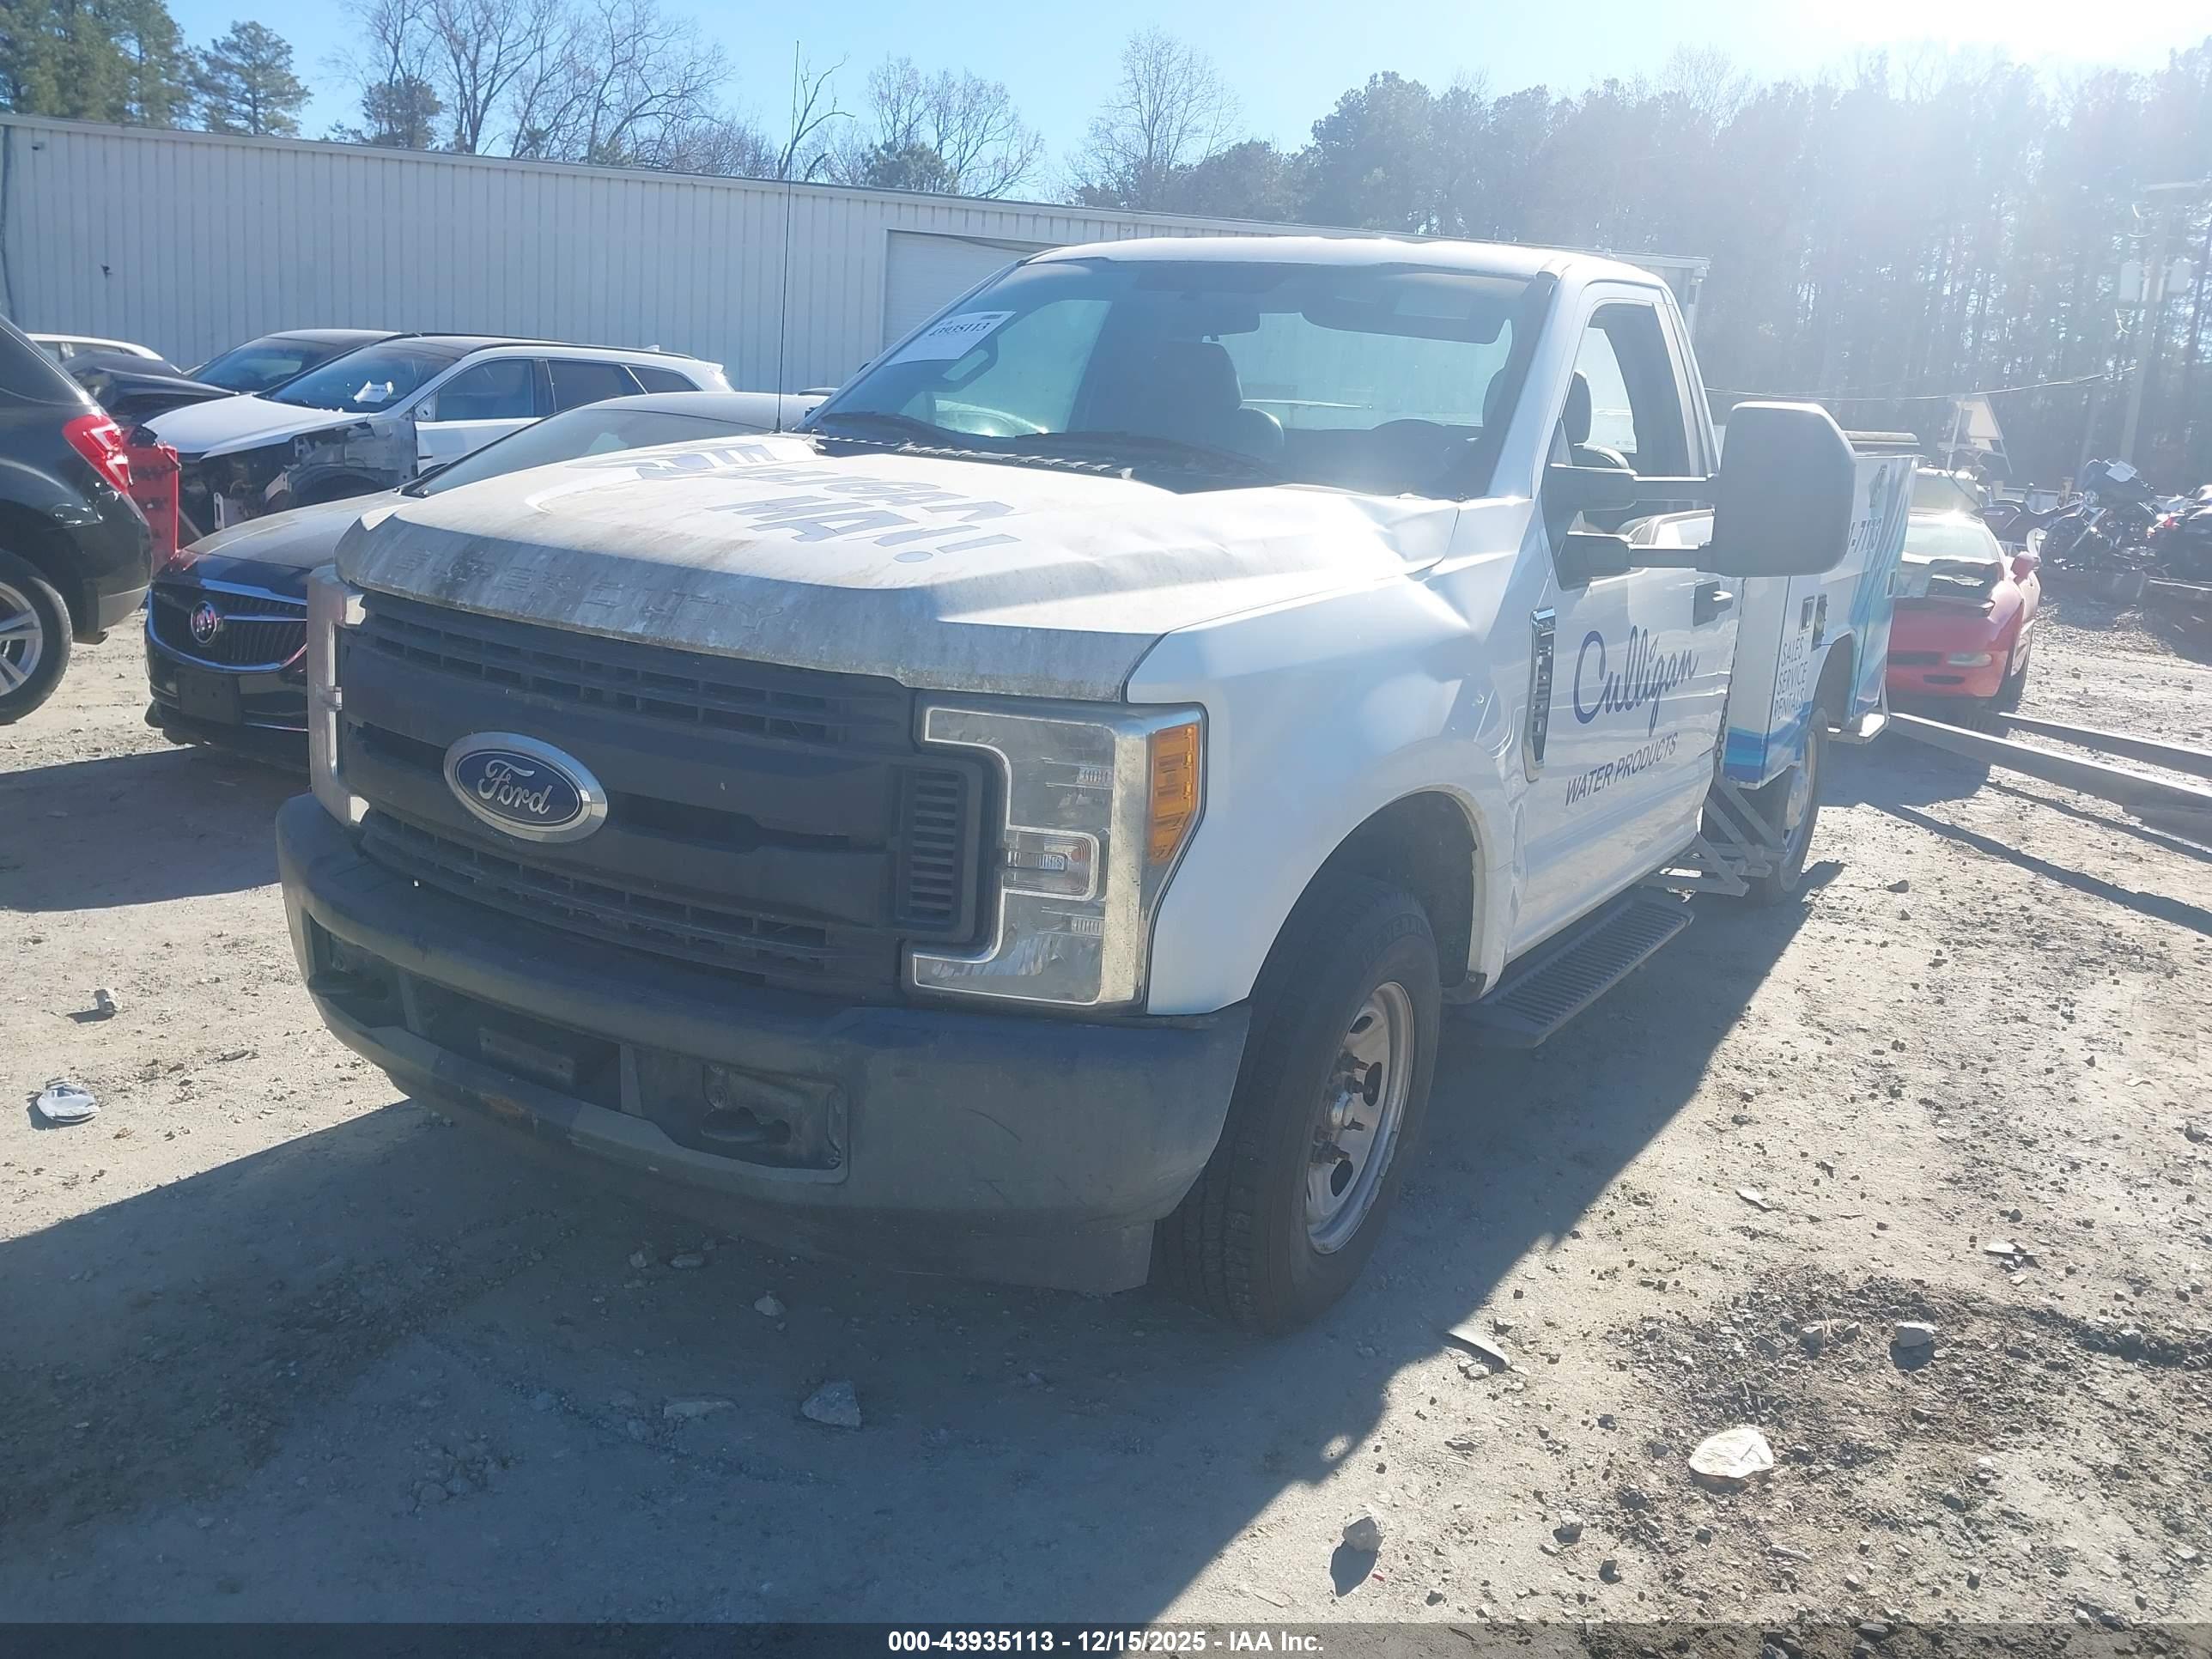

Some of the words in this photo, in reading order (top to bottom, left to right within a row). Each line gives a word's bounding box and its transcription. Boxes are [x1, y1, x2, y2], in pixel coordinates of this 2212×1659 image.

[1781, 635, 1804, 666] SALES
[1573, 625, 1699, 738] Culligan
[1778, 660, 1808, 696] SERVICE
[1773, 687, 1804, 722] RENTALS
[477, 759, 553, 815] Ford
[1565, 762, 1614, 806] WATER
[1614, 732, 1678, 783] PRODUCTS
